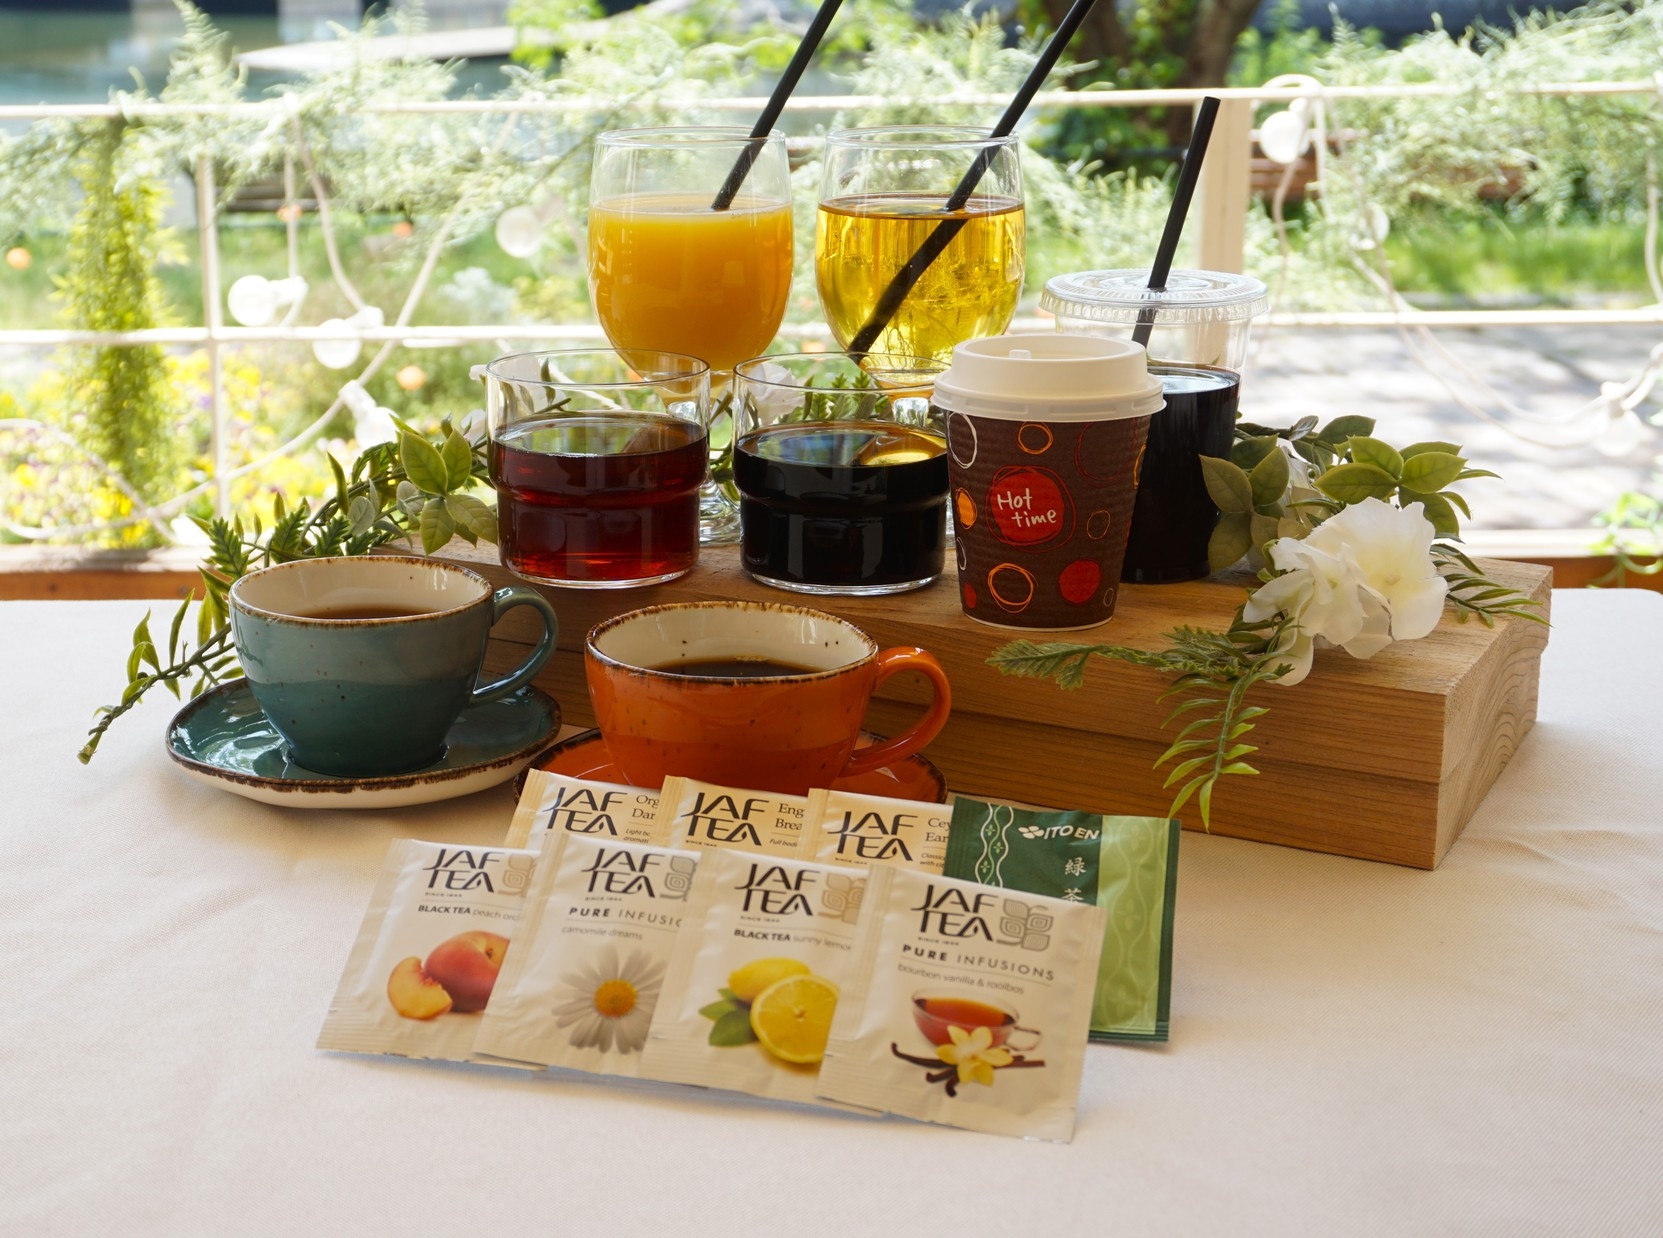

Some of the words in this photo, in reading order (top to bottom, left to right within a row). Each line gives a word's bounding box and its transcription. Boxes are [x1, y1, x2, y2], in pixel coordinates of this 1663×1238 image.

[997, 487, 1032, 510] Hot
[1011, 509, 1056, 527] time
[542, 787, 628, 812] JAF
[636, 794, 660, 809] Org
[681, 792, 770, 820] JAF
[778, 803, 805, 818] Eng
[547, 808, 617, 836] TEA
[632, 808, 656, 820] Dar
[827, 811, 918, 835] JAF
[928, 818, 950, 831] Cey
[625, 828, 641, 837] Light
[687, 814, 762, 846] TEA
[925, 832, 948, 843] Ear
[1044, 825, 1074, 840] ITO
[1074, 829, 1100, 840] EN
[837, 833, 913, 861] TEA
[422, 849, 505, 870] JAF
[581, 848, 666, 873] JAF
[428, 869, 494, 893] TEA
[588, 870, 655, 898] TEA
[734, 863, 820, 891] JAF
[742, 888, 813, 916] TEA
[910, 884, 999, 913] JAF
[418, 905, 452, 913] BLACK
[452, 906, 471, 914] TEA
[472, 908, 501, 919] peach
[569, 907, 610, 918] PURE
[562, 925, 606, 937] camomile
[608, 927, 643, 940] dreams
[734, 929, 769, 941] BLACK
[772, 933, 791, 942] TEA
[793, 935, 822, 945] sunny
[920, 909, 993, 942] TEA
[902, 944, 948, 962] PURE
[957, 954, 1055, 981] INFUSIONS
[898, 963, 941, 980] bourbon
[943, 971, 974, 986] vanilla
[977, 978, 985, 987] &
[986, 979, 1024, 994] rooibos
